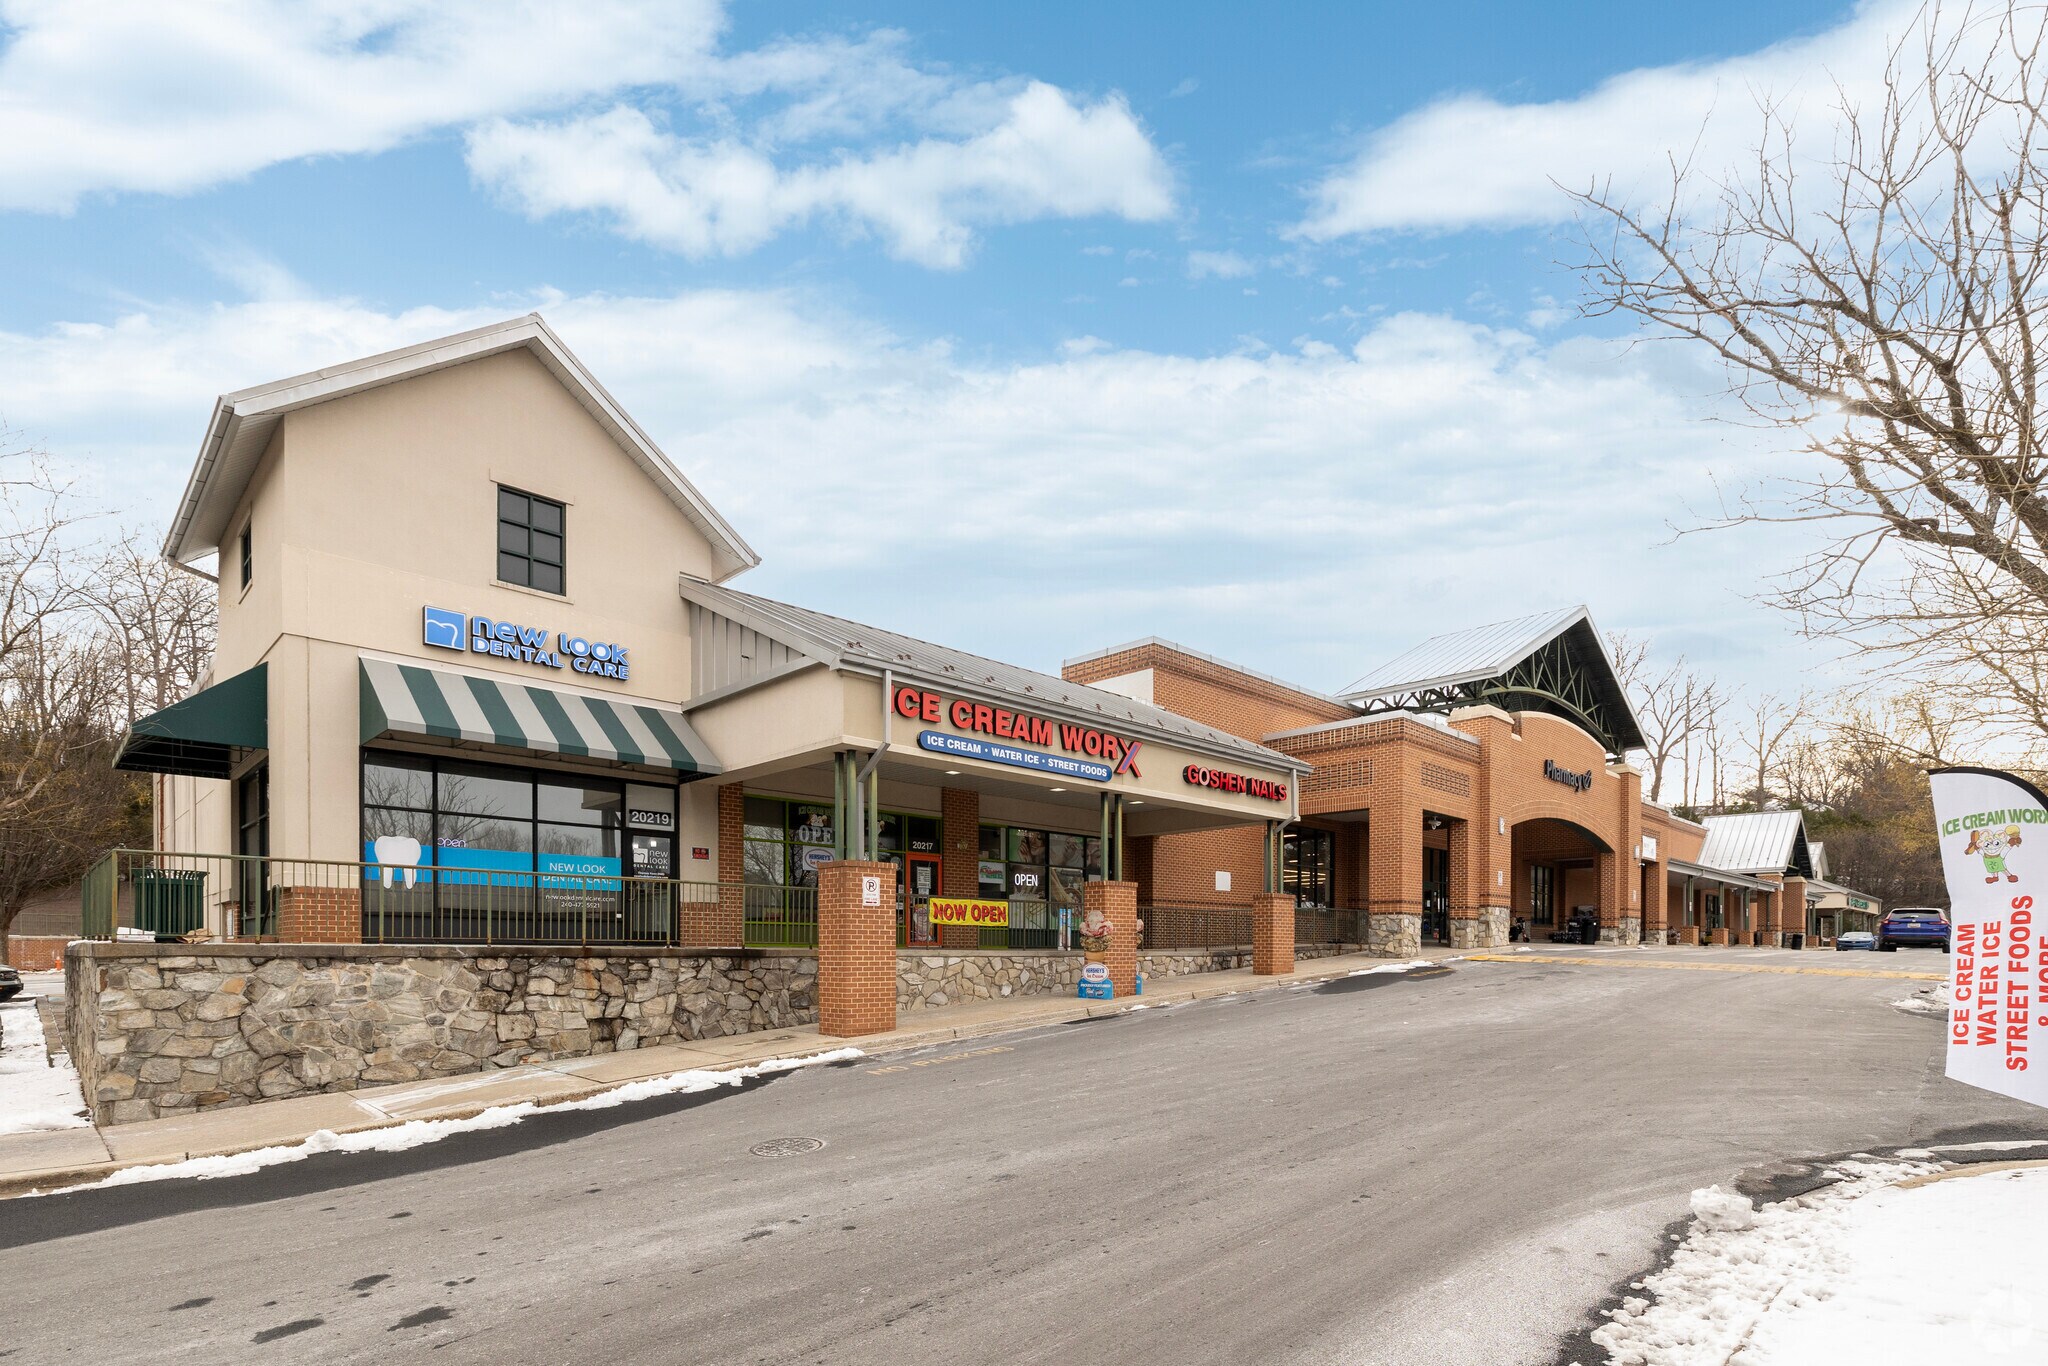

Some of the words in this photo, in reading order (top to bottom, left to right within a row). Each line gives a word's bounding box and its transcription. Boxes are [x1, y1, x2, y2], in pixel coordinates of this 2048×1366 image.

[471, 616, 549, 649] new
[471, 637, 565, 668] DENTAL
[571, 657, 630, 681] CARE
[891, 684, 942, 723] ICE
[950, 700, 1053, 747] CREAM
[1059, 723, 1143, 778] WORX
[927, 735, 945, 747] ICE
[947, 739, 982, 754] CREAM
[991, 747, 1022, 762] WATER
[1024, 754, 1039, 765] ICE
[1048, 758, 1079, 772] STREET
[1081, 764, 1107, 778] FOODS
[1185, 764, 1247, 793] GOSHEN
[1250, 777, 1287, 801] NAILS
[1545, 759, 1583, 793] Pharmacy
[631, 811, 670, 825] 20219
[1941, 818, 1961, 837] ICE
[1962, 809, 2006, 830] CREAM
[649, 850, 669, 858] new
[649, 857, 669, 865] look
[912, 841, 934, 851] 20217
[549, 862, 575, 872] NEW
[577, 864, 606, 874] LOOK
[1014, 873, 1039, 887] OPEN
[932, 902, 968, 921] NOW
[970, 904, 1007, 923] OPEN
[1982, 920, 2002, 958] ICE
[2008, 895, 2033, 973] FOODS
[1955, 924, 1976, 1002] CREAM
[1976, 964, 1999, 1047] WATER
[1953, 1008, 1970, 1046] ICE
[2005, 980, 2029, 1072] STREET
[865, 1065, 910, 1076] NO
[910, 1046, 1015, 1067] PARKING
